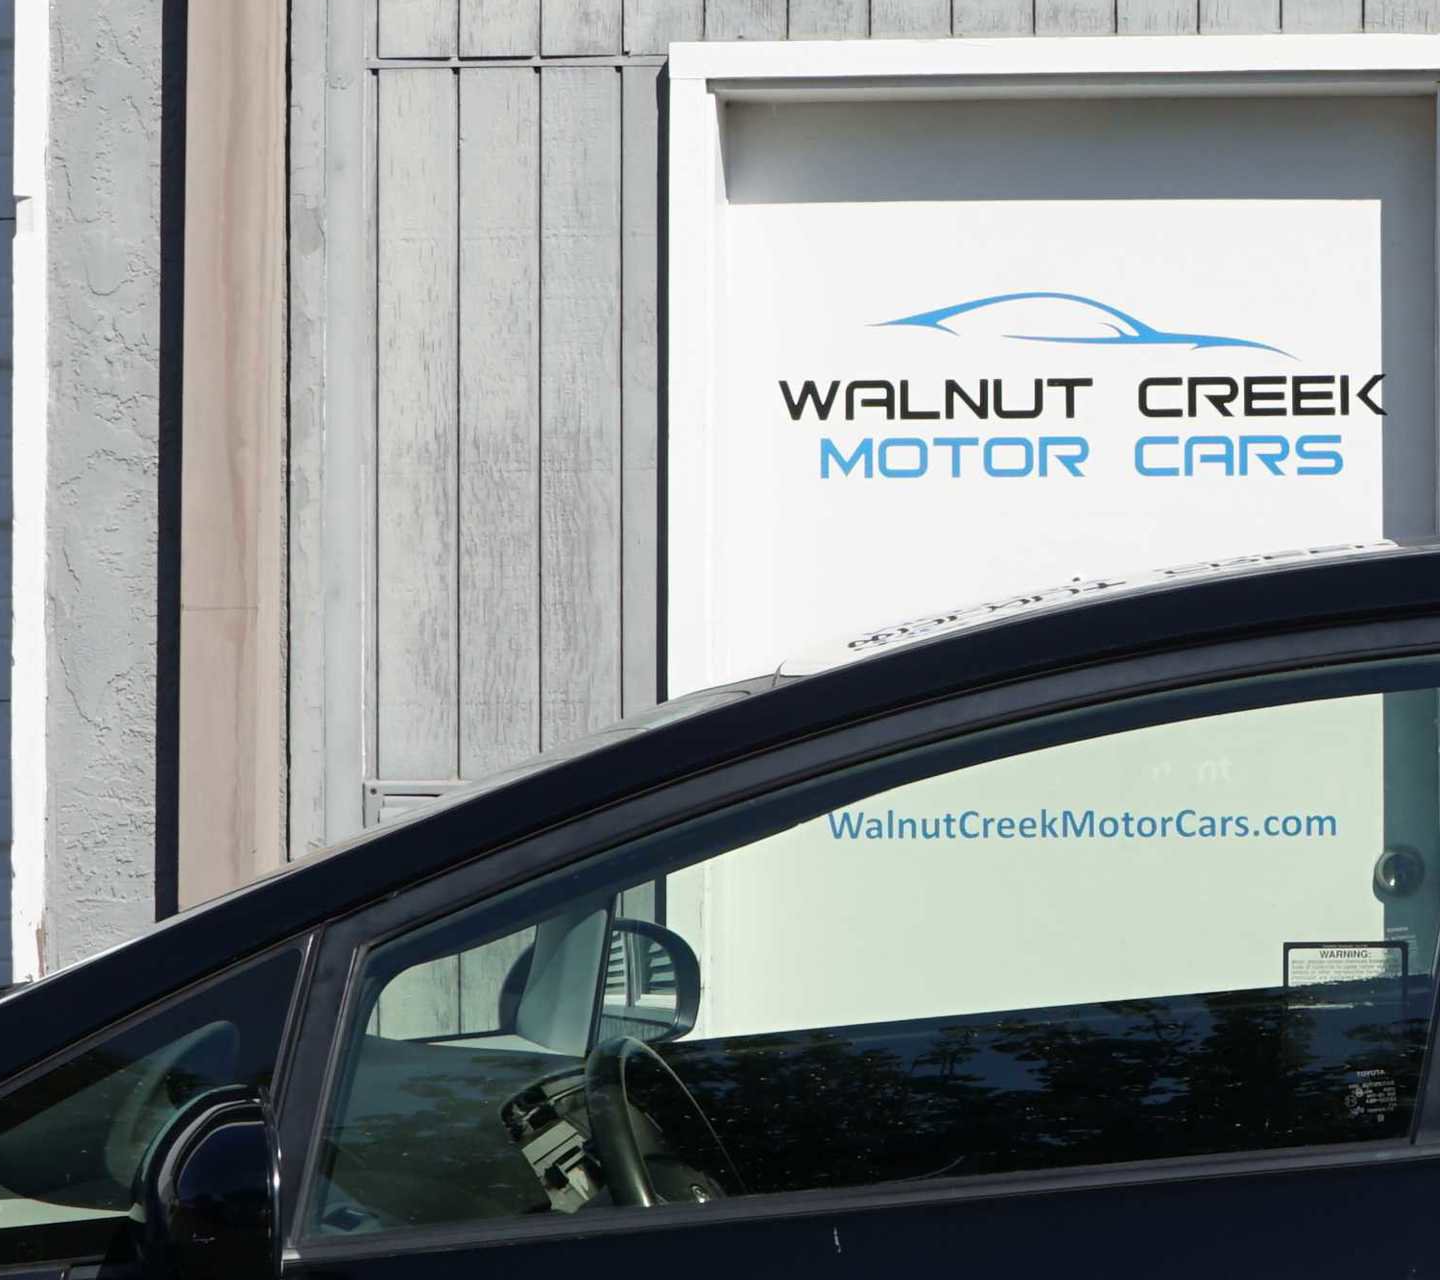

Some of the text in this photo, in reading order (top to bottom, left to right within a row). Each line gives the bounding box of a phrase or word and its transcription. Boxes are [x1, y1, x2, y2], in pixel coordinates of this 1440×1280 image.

[778, 373, 1388, 422] WALNUT CREEK
[819, 434, 1345, 480] MOTOR CARS
[828, 808, 1338, 841] WalnutCreekMotorCars.com
